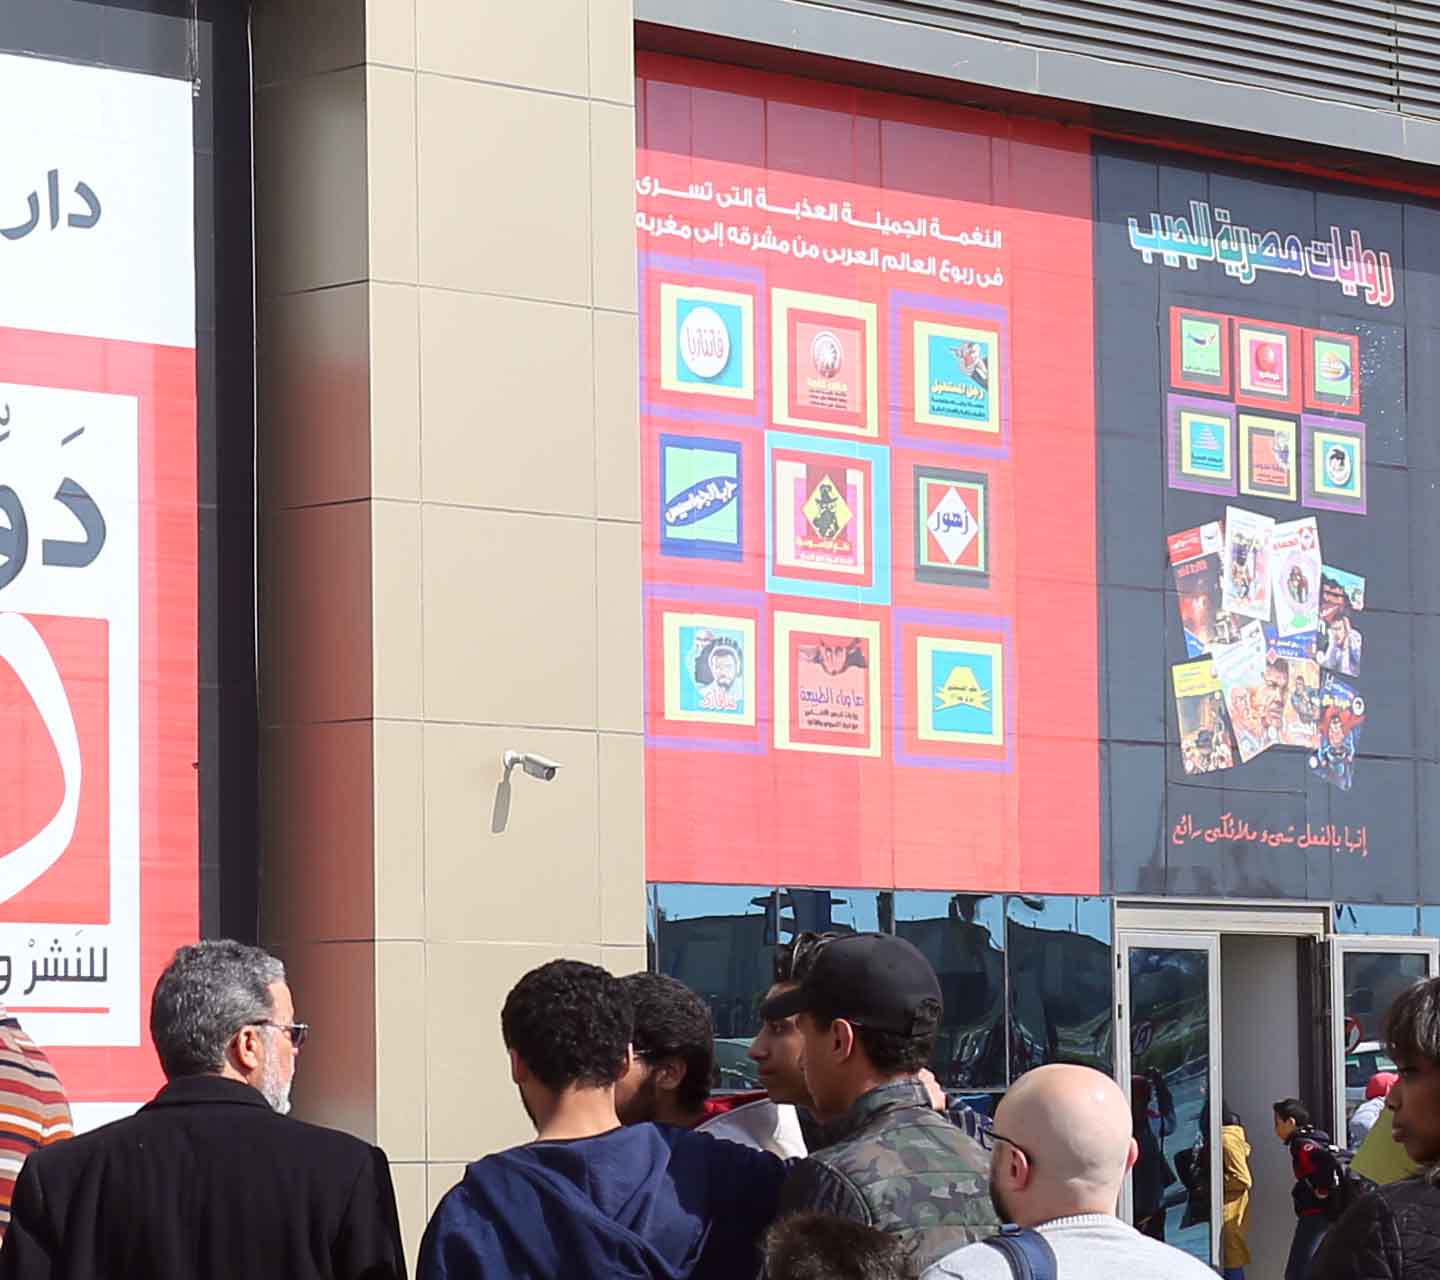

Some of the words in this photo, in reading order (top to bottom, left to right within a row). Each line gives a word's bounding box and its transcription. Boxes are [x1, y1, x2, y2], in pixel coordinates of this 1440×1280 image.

[792, 235, 819, 257] من
[1128, 201, 1214, 270] للجيب
[1215, 207, 1304, 284] مصرية
[882, 252, 936, 274] العالم
[1306, 226, 1394, 307] روايات
[933, 508, 969, 535] زهور
